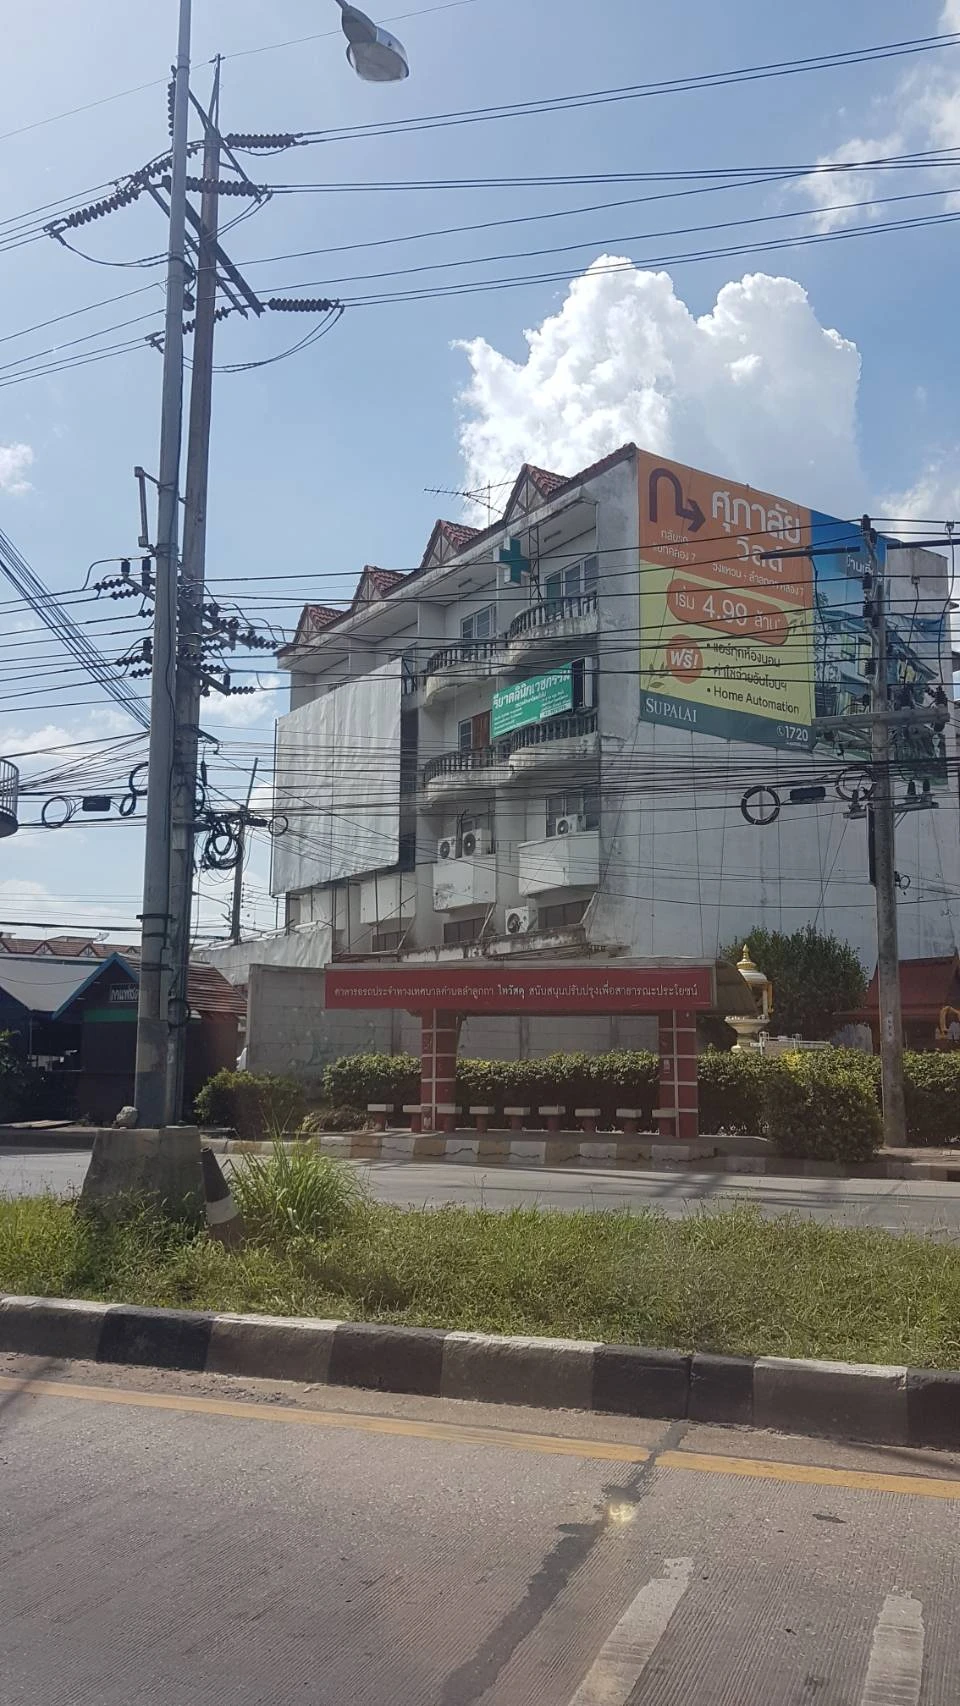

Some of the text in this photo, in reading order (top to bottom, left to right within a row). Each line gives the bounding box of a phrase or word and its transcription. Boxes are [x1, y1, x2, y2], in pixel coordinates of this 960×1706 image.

[711, 490, 801, 545] ศุภาลัย
[675, 586, 695, 610] เริ่ม
[702, 595, 748, 626] 4.99
[670, 648, 699, 669] ฟรี!
[645, 698, 697, 723] SUPALAI
[713, 686, 800, 715] Home Automation
[784, 726, 809, 742] 1720
[497, 984, 525, 999] ไทวัสดุ
